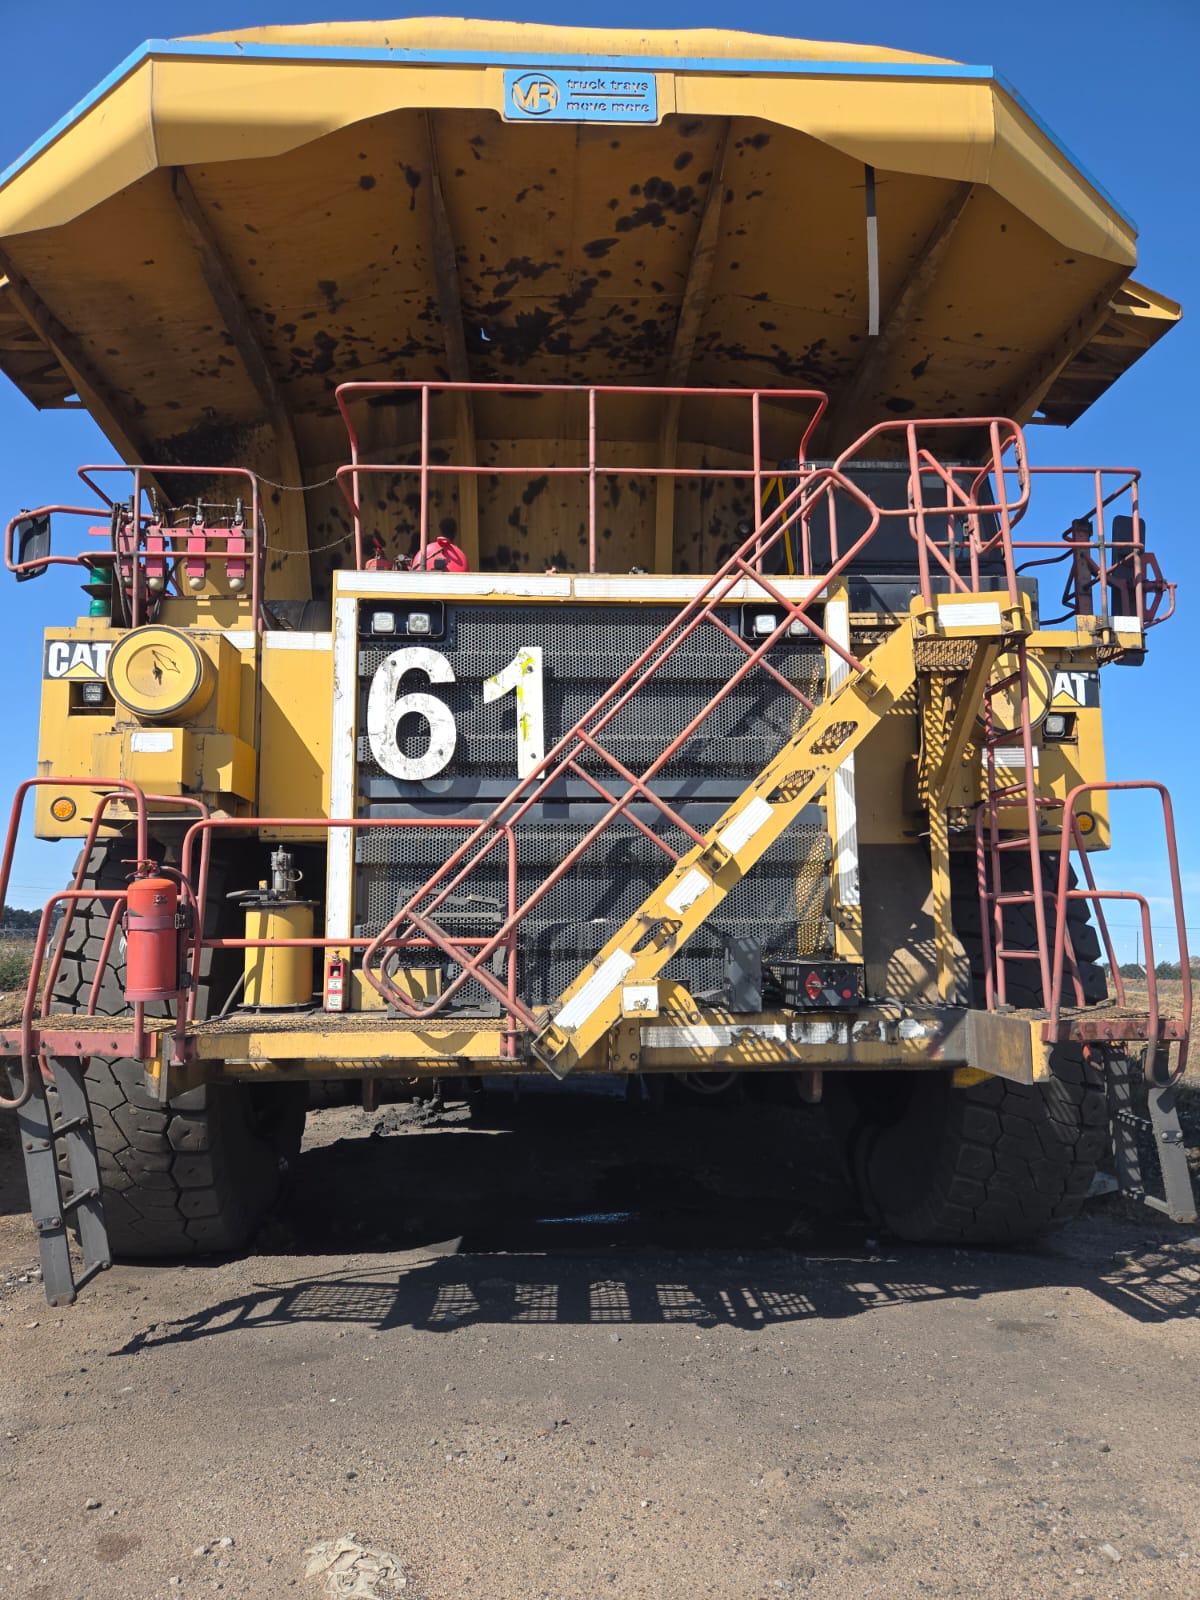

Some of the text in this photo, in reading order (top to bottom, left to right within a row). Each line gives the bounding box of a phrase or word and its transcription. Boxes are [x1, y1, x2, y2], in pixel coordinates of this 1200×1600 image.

[566, 78, 649, 93] truck trays
[566, 101, 650, 112] move more
[48, 641, 112, 678] CAT
[1053, 672, 1089, 706] AT
[367, 646, 545, 780] 61
